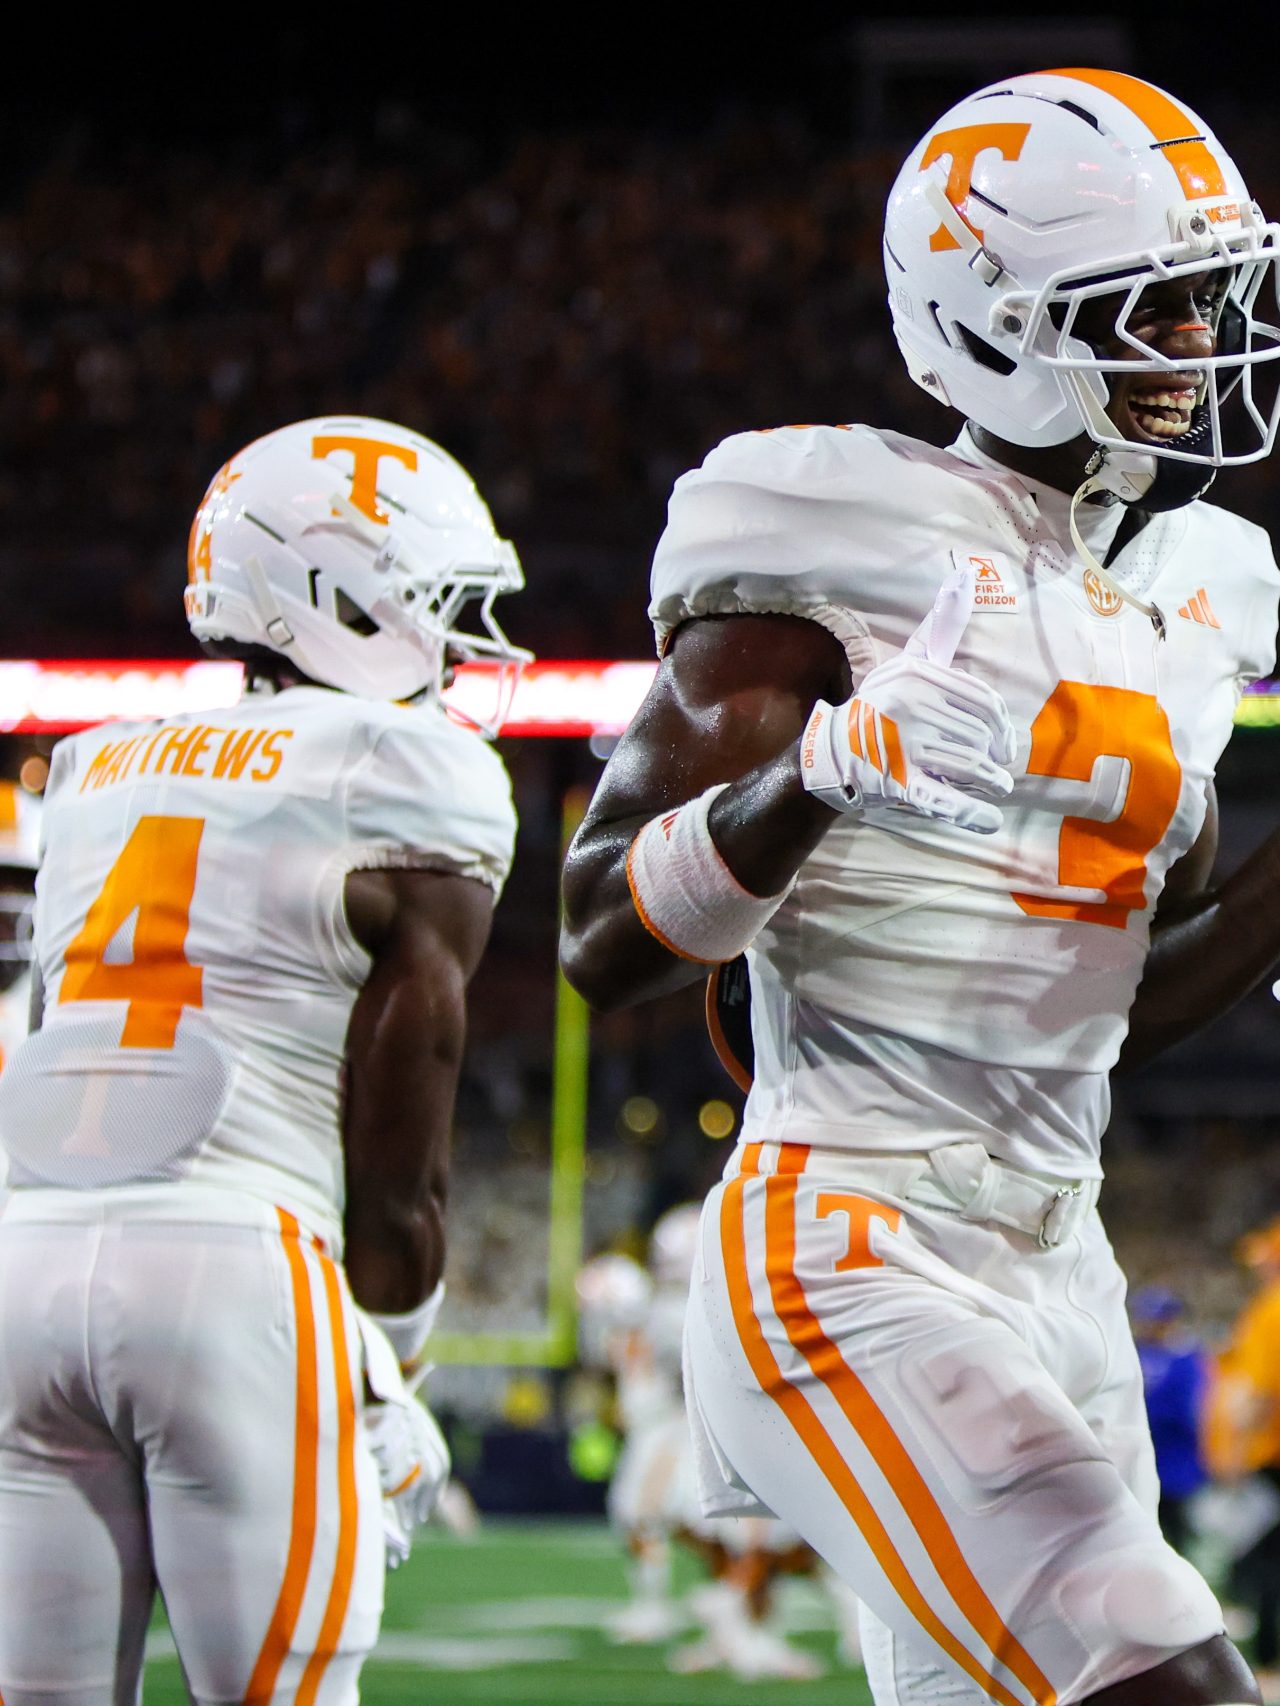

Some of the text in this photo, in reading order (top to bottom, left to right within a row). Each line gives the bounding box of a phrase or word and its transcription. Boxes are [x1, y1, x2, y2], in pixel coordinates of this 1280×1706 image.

[919, 123, 1031, 252] T
[312, 436, 417, 524] T
[974, 596, 1016, 606] ORIZON
[975, 585, 1005, 594] FIRST
[79, 723, 294, 795] MATTHEWS
[804, 711, 823, 768] ADIZERO
[58, 816, 205, 1049] 4
[816, 1193, 901, 1272] T
